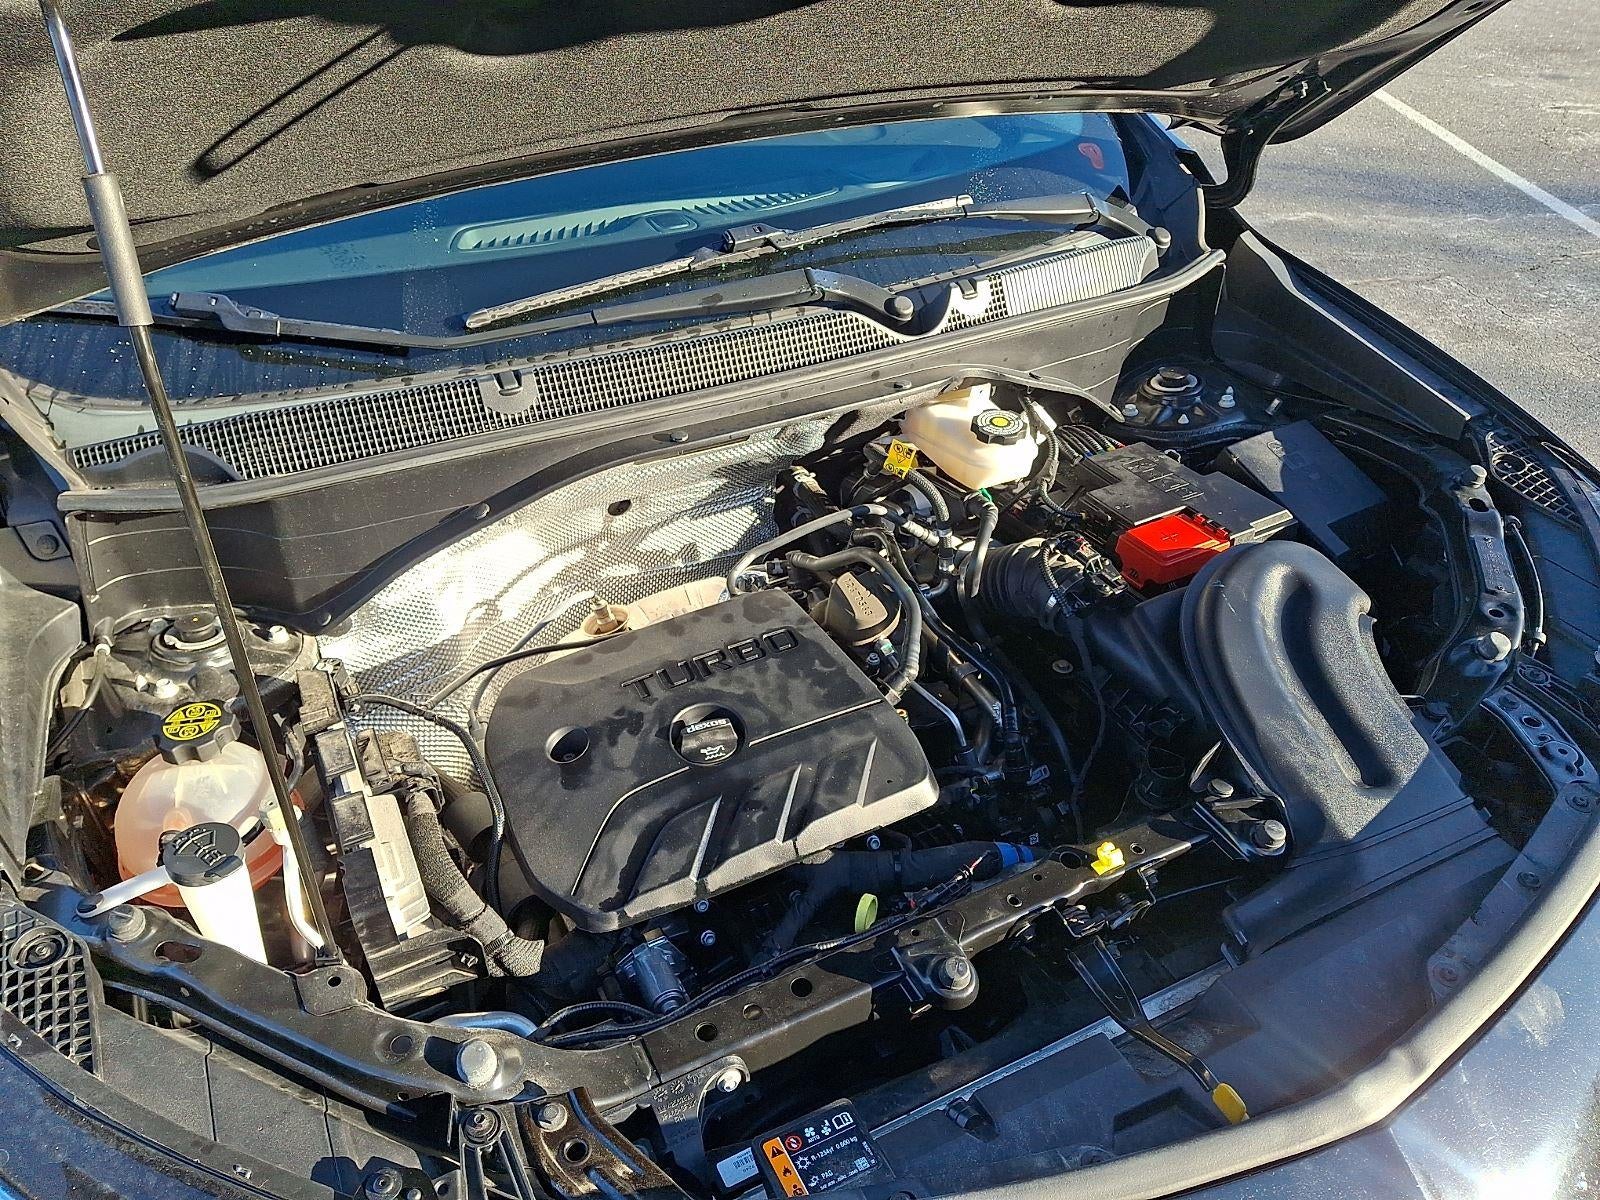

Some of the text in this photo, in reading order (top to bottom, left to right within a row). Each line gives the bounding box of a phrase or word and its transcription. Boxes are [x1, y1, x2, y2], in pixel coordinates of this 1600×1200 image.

[621, 626, 799, 700] TURBO
[686, 718, 727, 734] dexos
[821, 1169, 834, 1180] PAG
